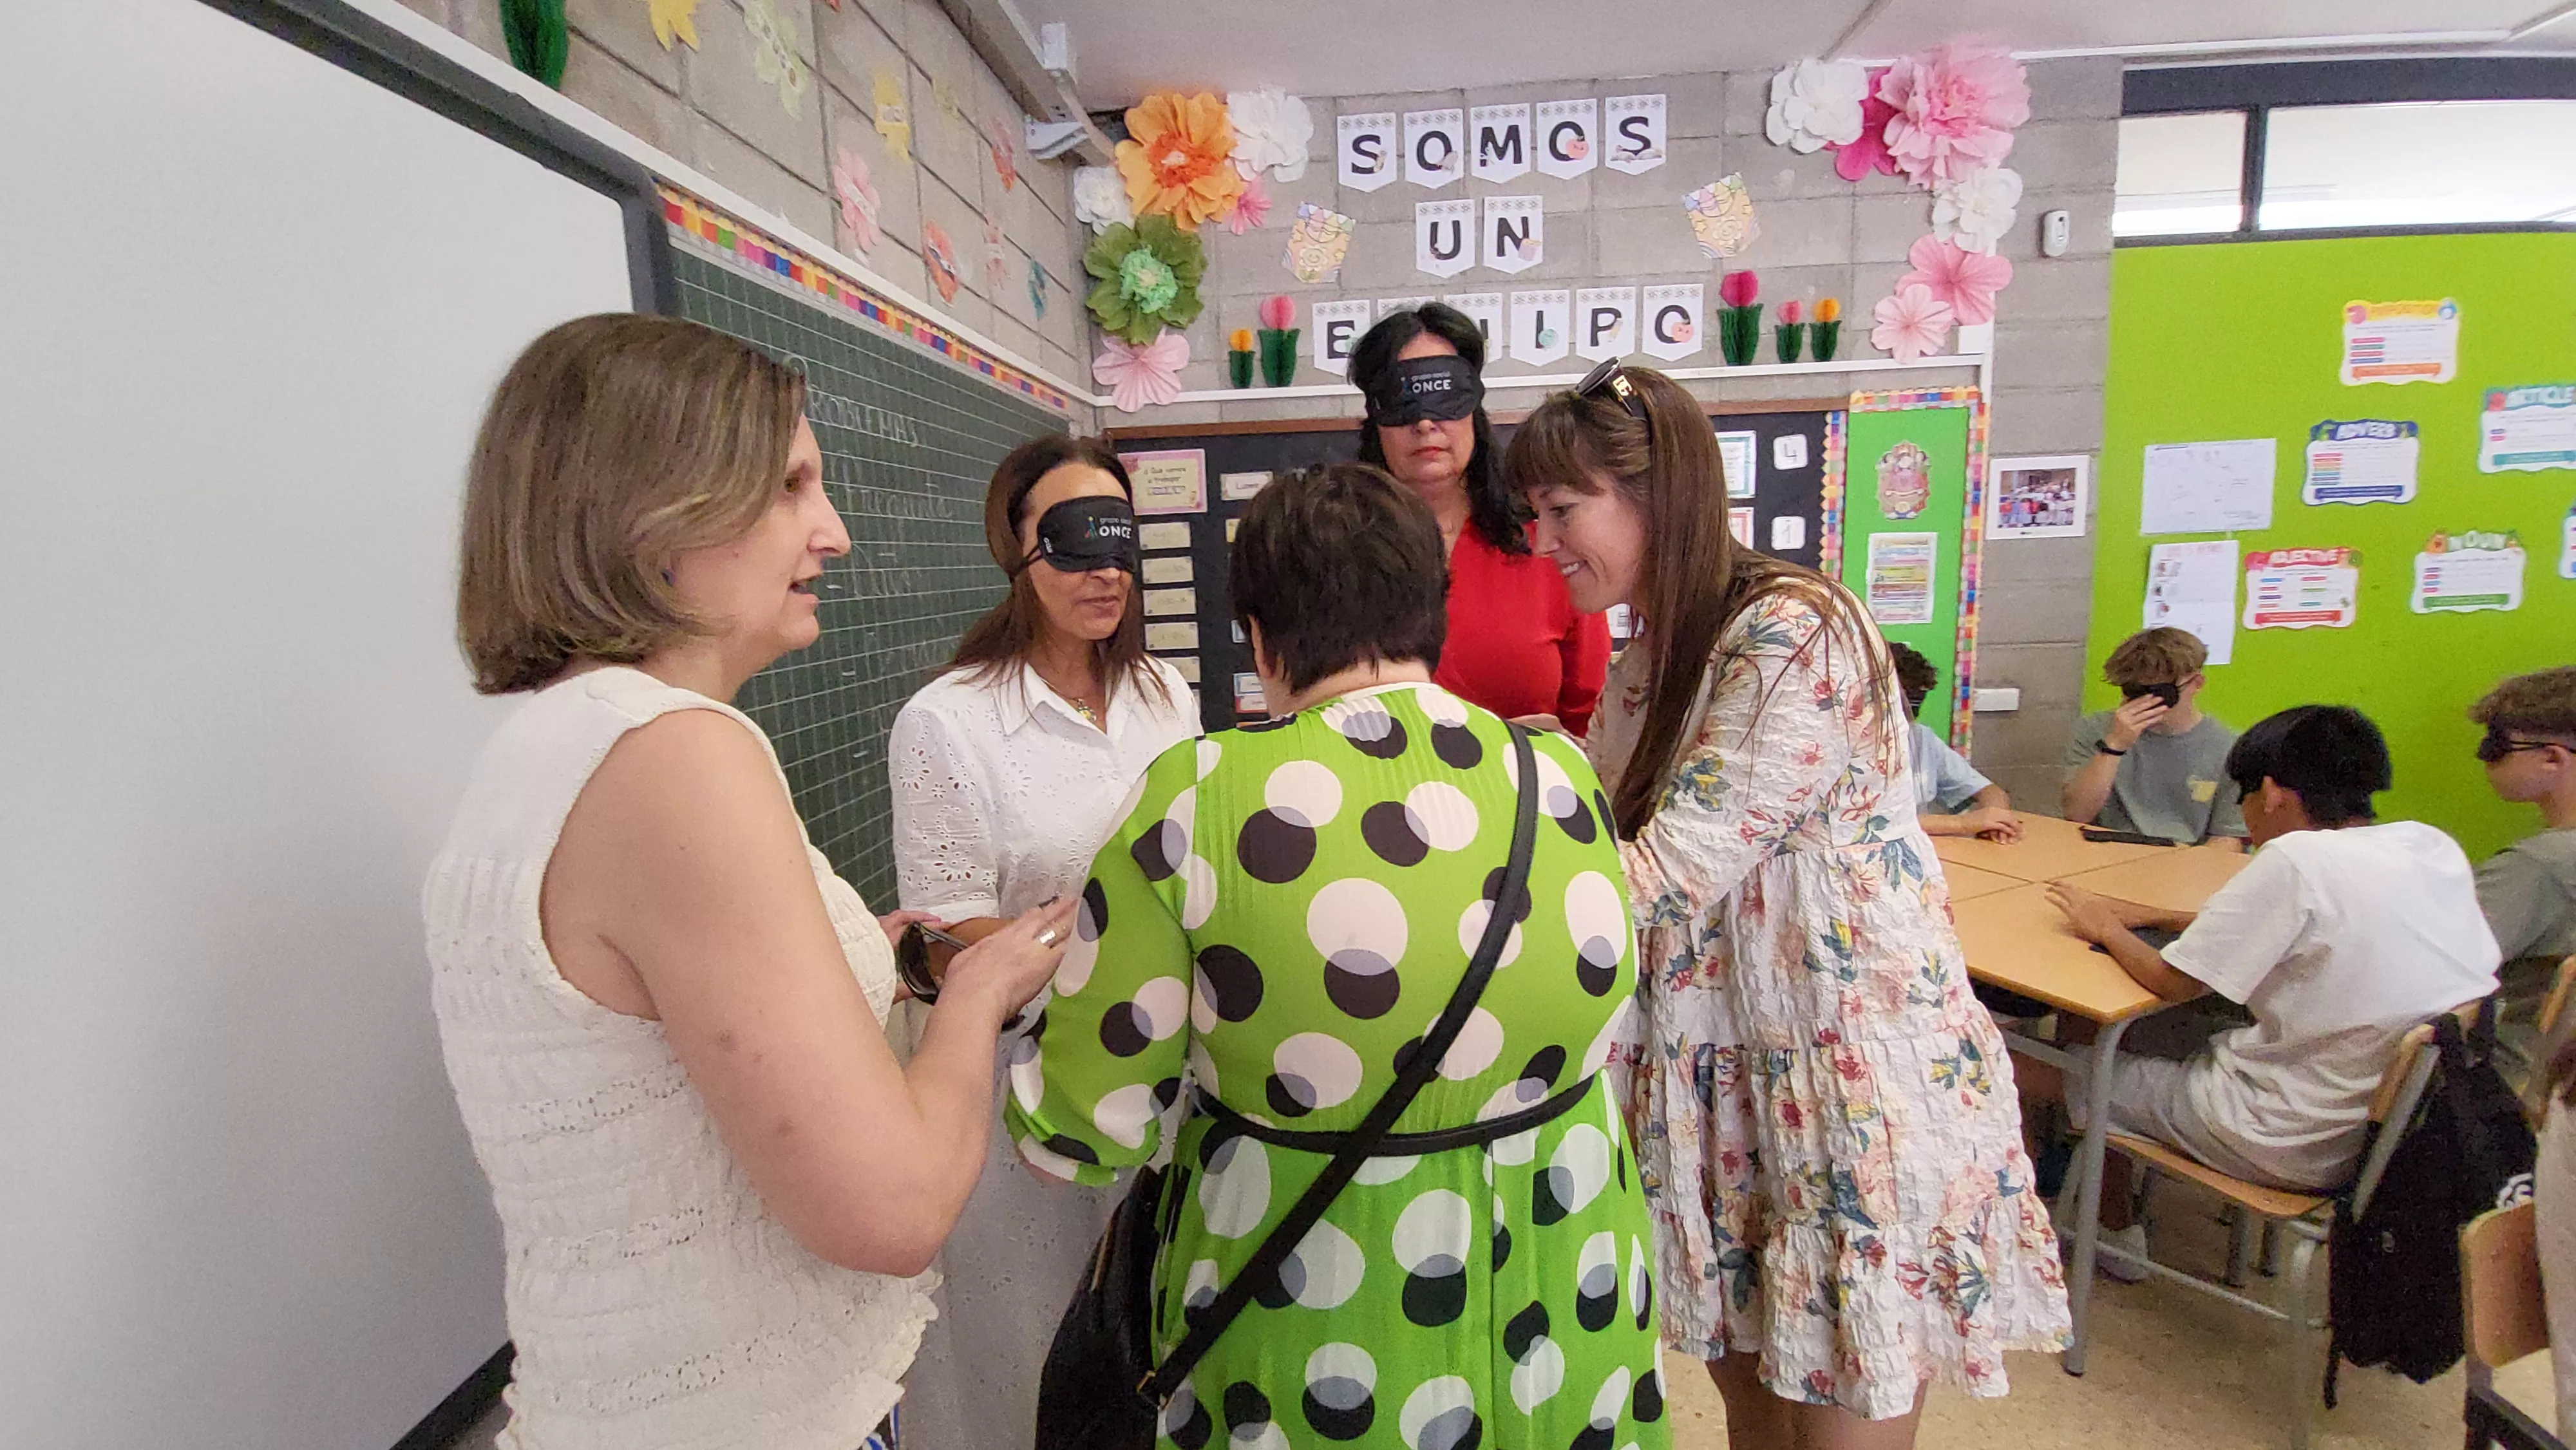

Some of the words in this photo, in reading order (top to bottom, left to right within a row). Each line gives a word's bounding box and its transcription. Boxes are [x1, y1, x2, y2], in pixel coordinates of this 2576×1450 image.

[1351, 115, 1651, 174] SOMOS
[1430, 216, 1530, 260] UN
[1327, 305, 1692, 359] EIPO
[1412, 379, 1452, 394] ONCE
[1099, 525, 1132, 539] ONCE
